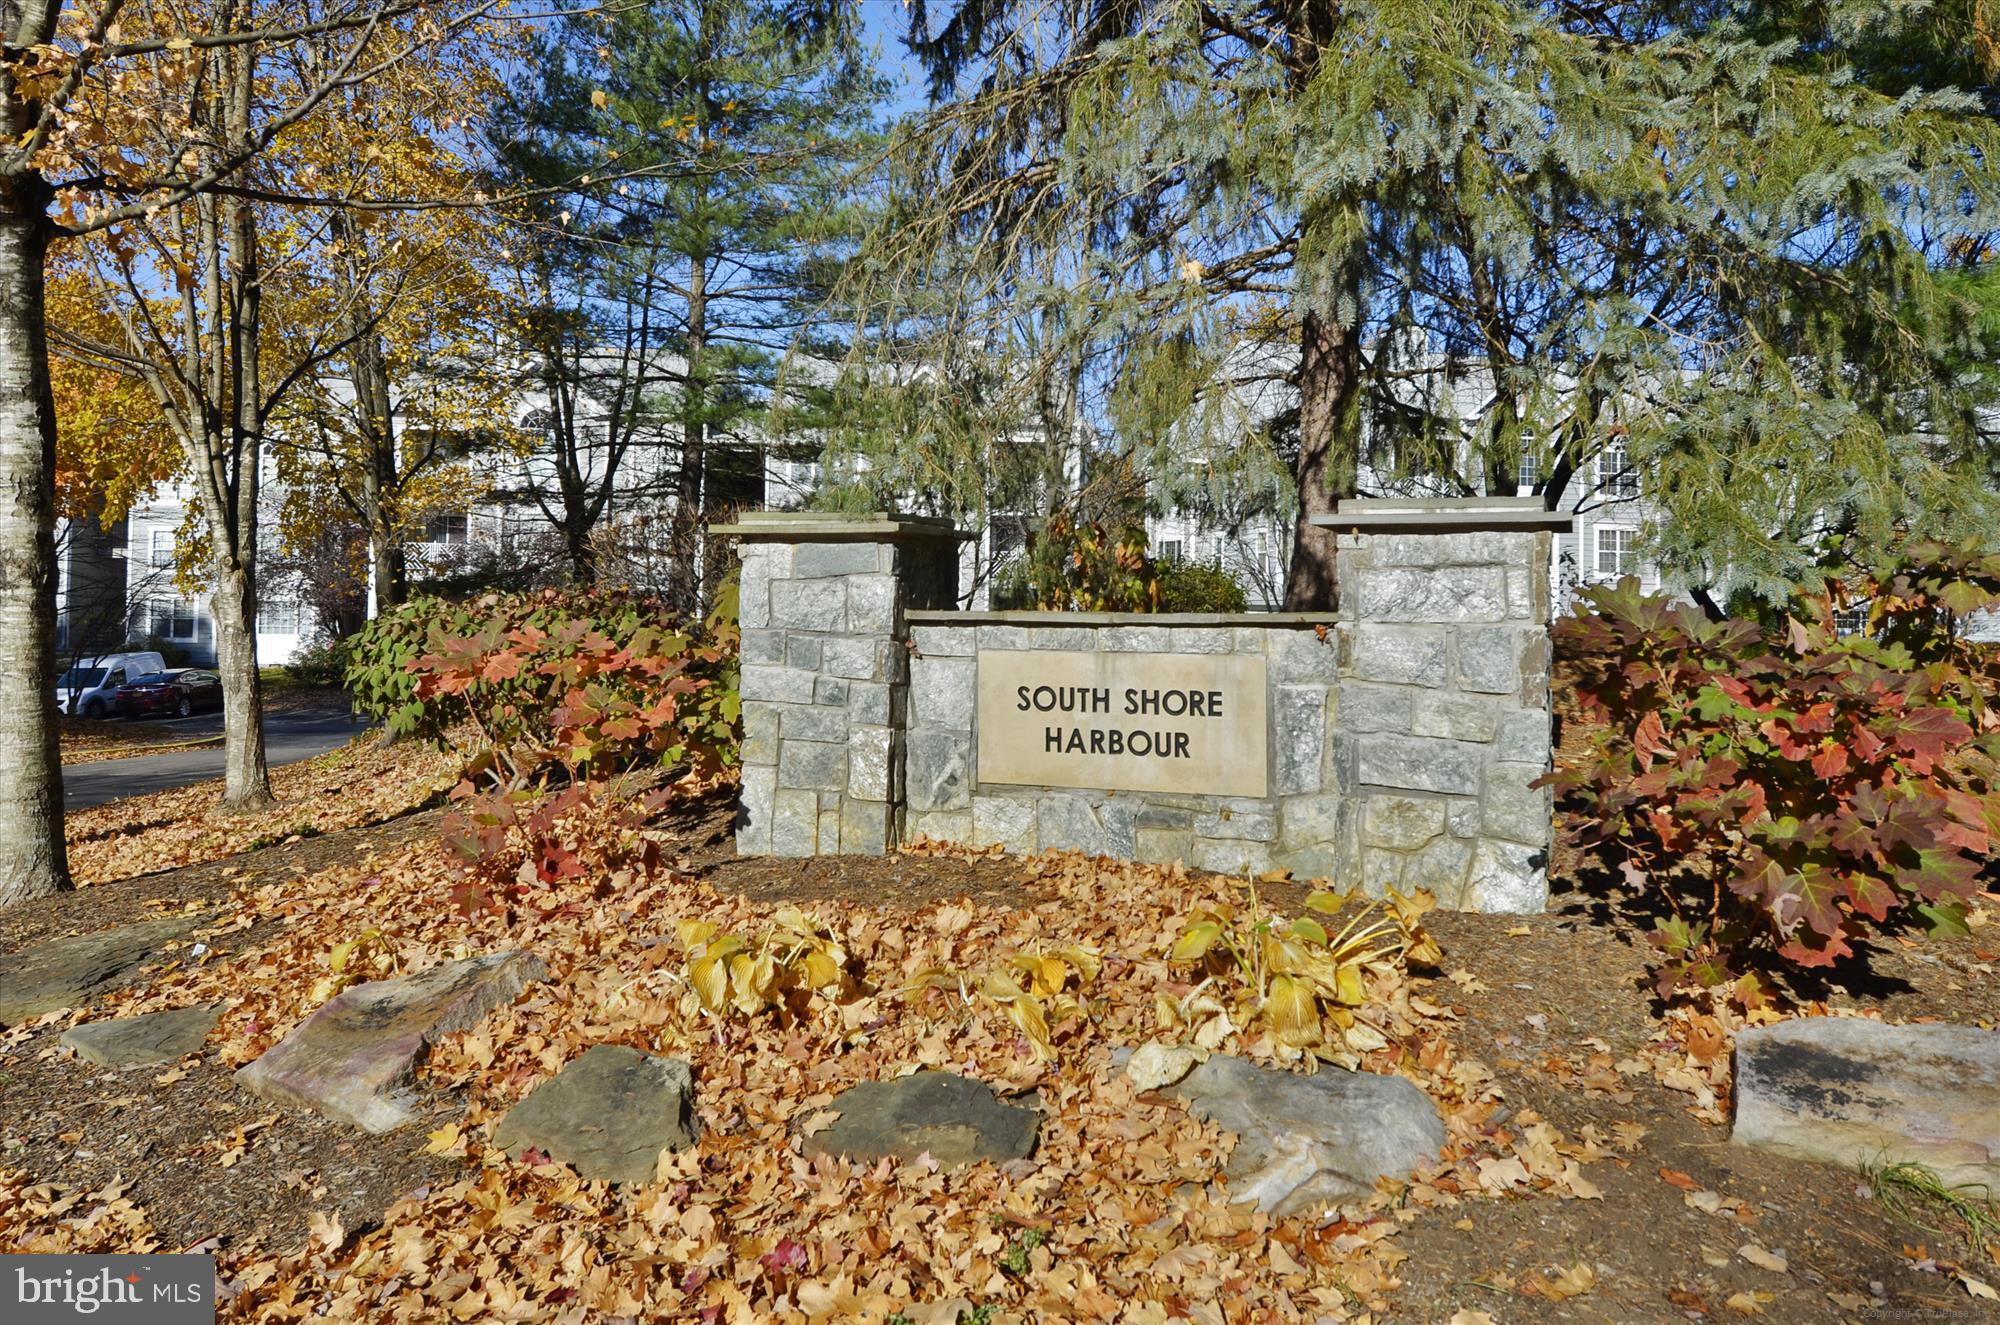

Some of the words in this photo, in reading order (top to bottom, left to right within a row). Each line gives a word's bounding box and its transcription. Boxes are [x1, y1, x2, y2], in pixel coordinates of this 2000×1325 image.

[1016, 685, 1111, 714] SOUTH
[1123, 688, 1223, 717] SHORE
[1044, 726, 1191, 759] HARBOUR
